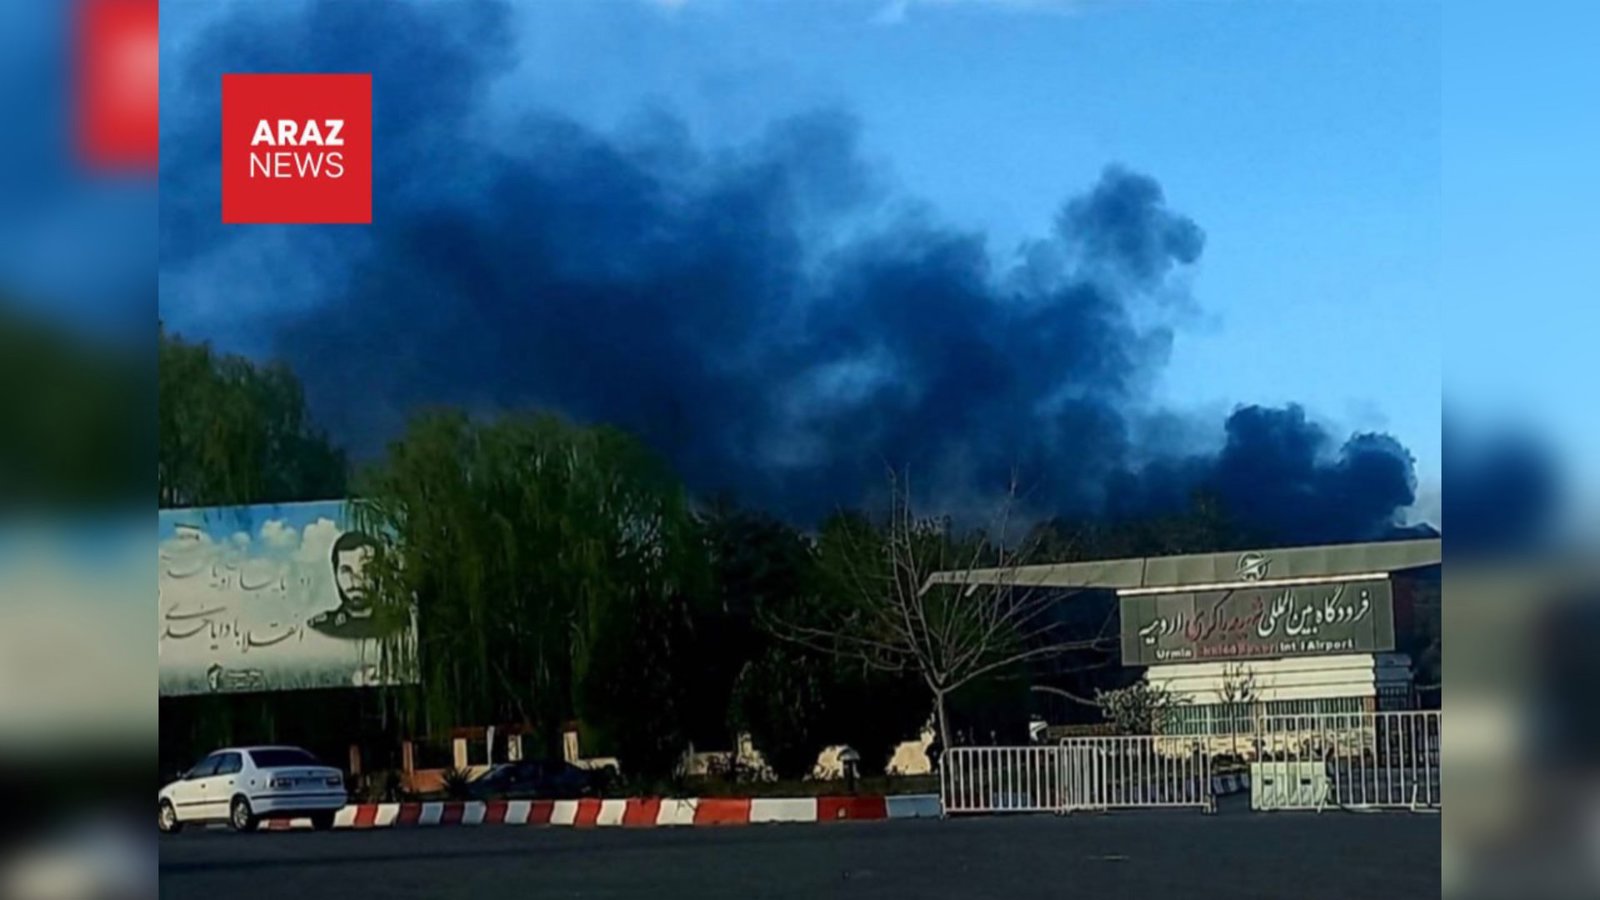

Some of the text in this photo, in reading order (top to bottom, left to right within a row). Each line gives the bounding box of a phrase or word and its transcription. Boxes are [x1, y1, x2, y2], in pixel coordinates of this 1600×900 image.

[1314, 583, 1370, 624] فرودگاه
[1138, 612, 1184, 645] ارومیه
[1156, 647, 1193, 660] Urmia
[1306, 638, 1354, 651] Airport
